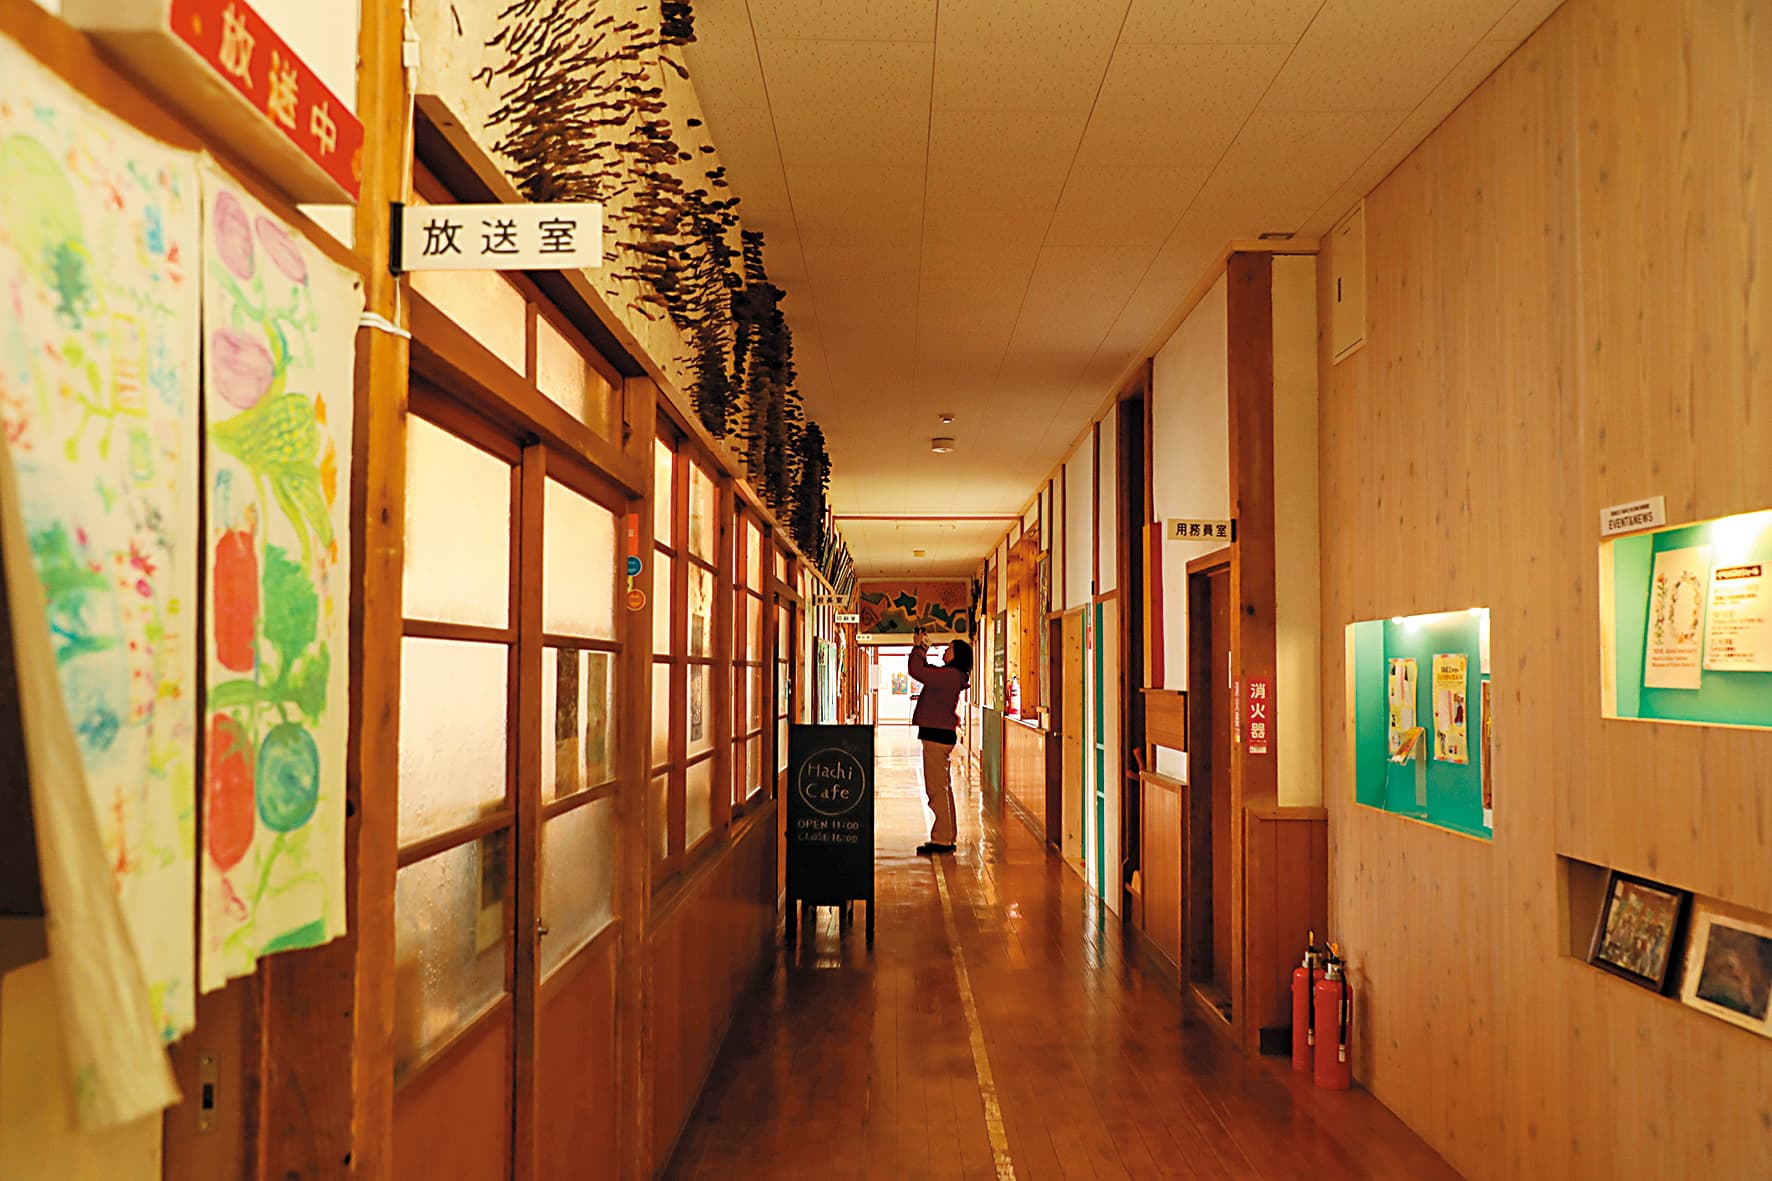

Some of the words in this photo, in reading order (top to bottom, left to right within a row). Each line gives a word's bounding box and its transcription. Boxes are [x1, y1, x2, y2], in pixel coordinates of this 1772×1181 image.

[218, 6, 341, 158] 放送中
[423, 217, 578, 257] 放送室
[1175, 522, 1228, 538] 用務員室
[1608, 512, 1654, 530] EVENT&NEWS
[1250, 682, 1266, 739] 消火器
[808, 760, 853, 781] Hachi
[805, 783, 850, 800] Cafe
[797, 818, 828, 829] OPEN
[832, 820, 859, 830] 11:00
[798, 832, 829, 842] CLOSE
